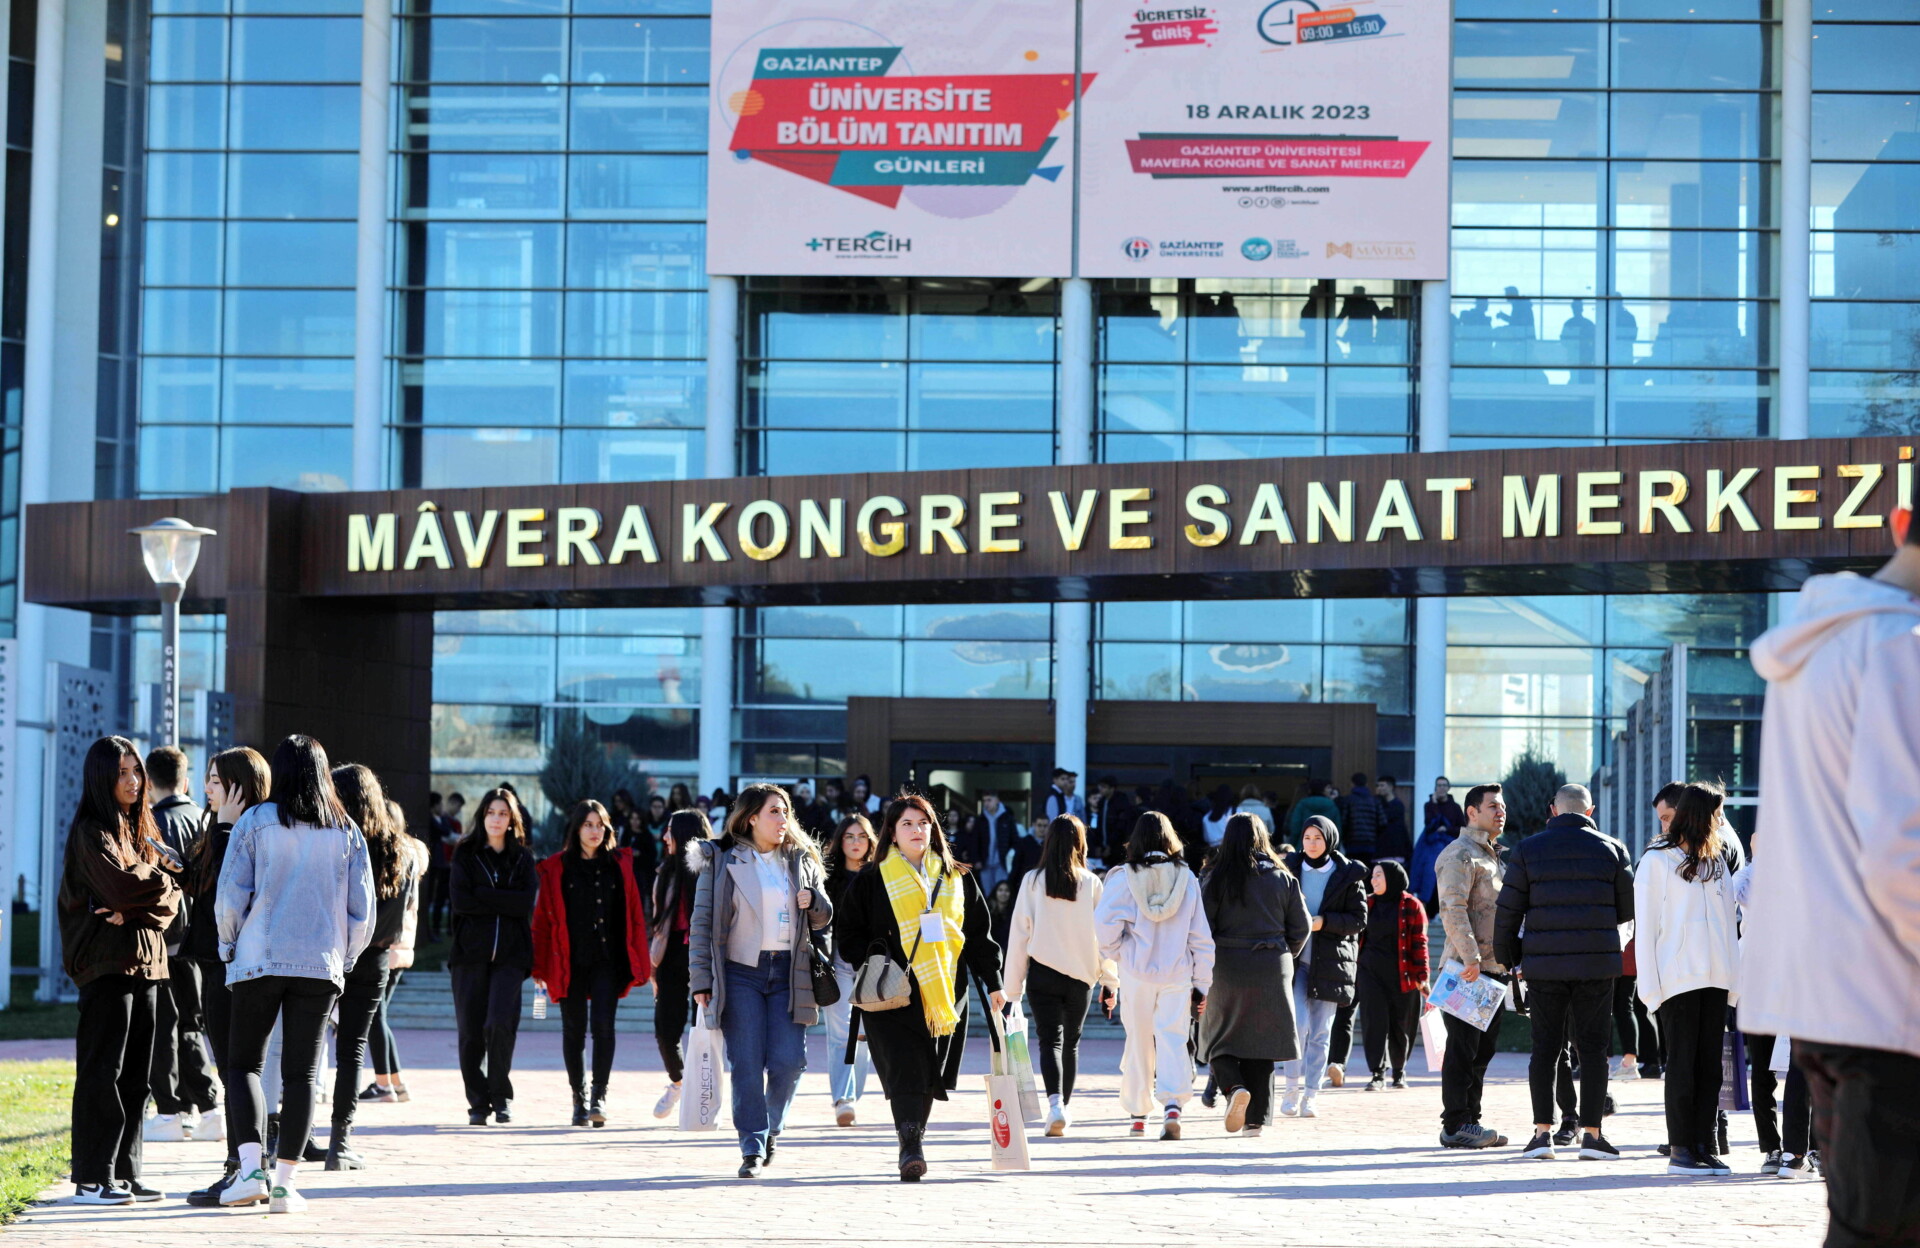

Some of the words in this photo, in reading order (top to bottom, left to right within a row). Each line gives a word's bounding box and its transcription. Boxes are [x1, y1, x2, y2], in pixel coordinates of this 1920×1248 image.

[1137, 6, 1208, 22] ÜCRETSİZ
[1152, 25, 1193, 41] GİRİŞ
[1300, 25, 1334, 41] 09:00
[1345, 20, 1380, 36] 16:00
[763, 54, 882, 71] GAZİANTEP
[809, 83, 992, 112] ÜNİVERSİTE
[1185, 104, 1210, 120] 18
[1217, 104, 1305, 120] ARALIK
[1311, 105, 1371, 120] 2023
[777, 117, 888, 146] BÖLÜM
[896, 122, 1023, 146] TANITIM
[1180, 144, 1262, 156] GAZİANTEP
[1264, 144, 1362, 157] ÜNİVERSİTESİ
[874, 157, 985, 174] GÜNLERİ
[1140, 158, 1201, 168] MAVERA
[1204, 158, 1265, 169] KONGRE
[1268, 159, 1286, 169] VE
[1290, 159, 1337, 169] SANAT
[1341, 157, 1406, 170] MERKEZİ
[1159, 239, 1224, 249] GAZİANTEP
[347, 501, 661, 572] MÂVERA
[682, 491, 1023, 562] KONGRE
[1047, 488, 1154, 551] VE
[1184, 478, 1475, 547] SANAT
[1502, 446, 1915, 539] MERKEZİ
